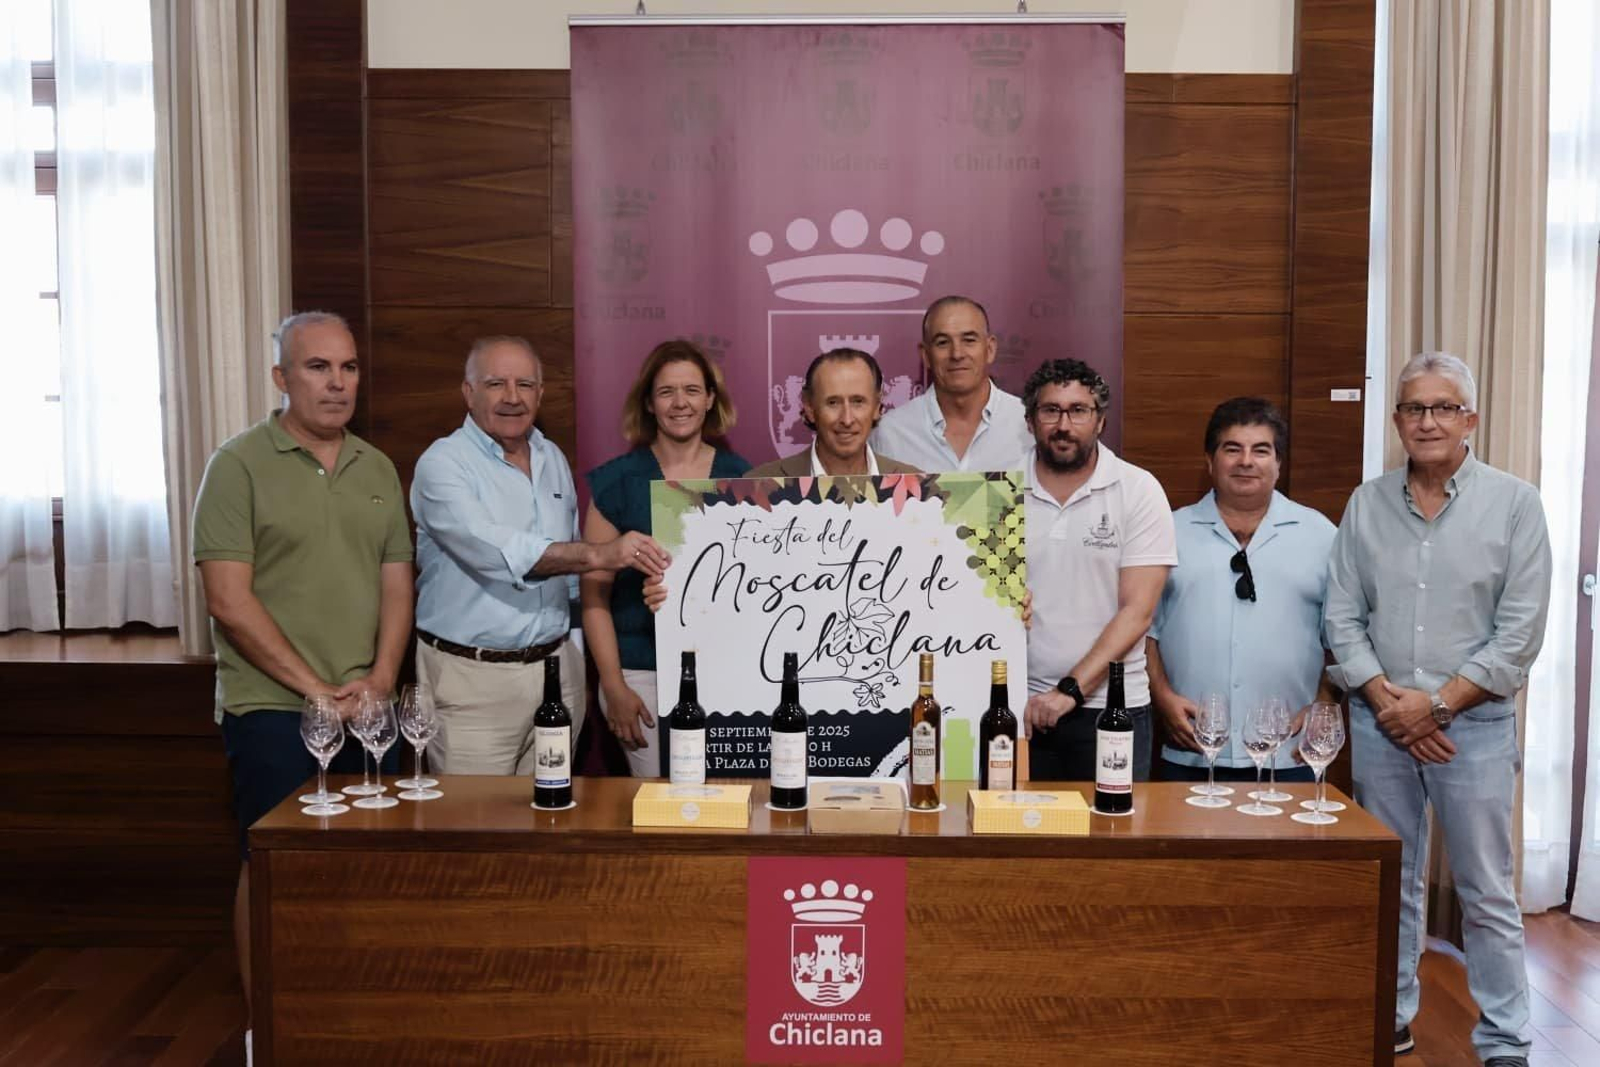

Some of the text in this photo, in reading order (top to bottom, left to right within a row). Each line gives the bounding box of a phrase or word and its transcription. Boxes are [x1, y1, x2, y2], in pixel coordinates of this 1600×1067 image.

[726, 516, 854, 558] Fiesta del
[680, 538, 959, 627] Moscatel de
[760, 604, 1002, 684] Chiclana
[709, 726, 772, 738] SEPTIEM
[807, 726, 815, 736] E
[818, 725, 850, 737] 2025
[706, 742, 733, 753] RTIR
[736, 742, 754, 753] DE
[758, 742, 773, 753] LA
[821, 741, 832, 752] H
[715, 756, 756, 769] PLAZA
[808, 755, 872, 768] BODEGAS
[781, 1012, 871, 1022] AYUNTAMIENTO DE
[769, 1022, 883, 1046] Chiclana
